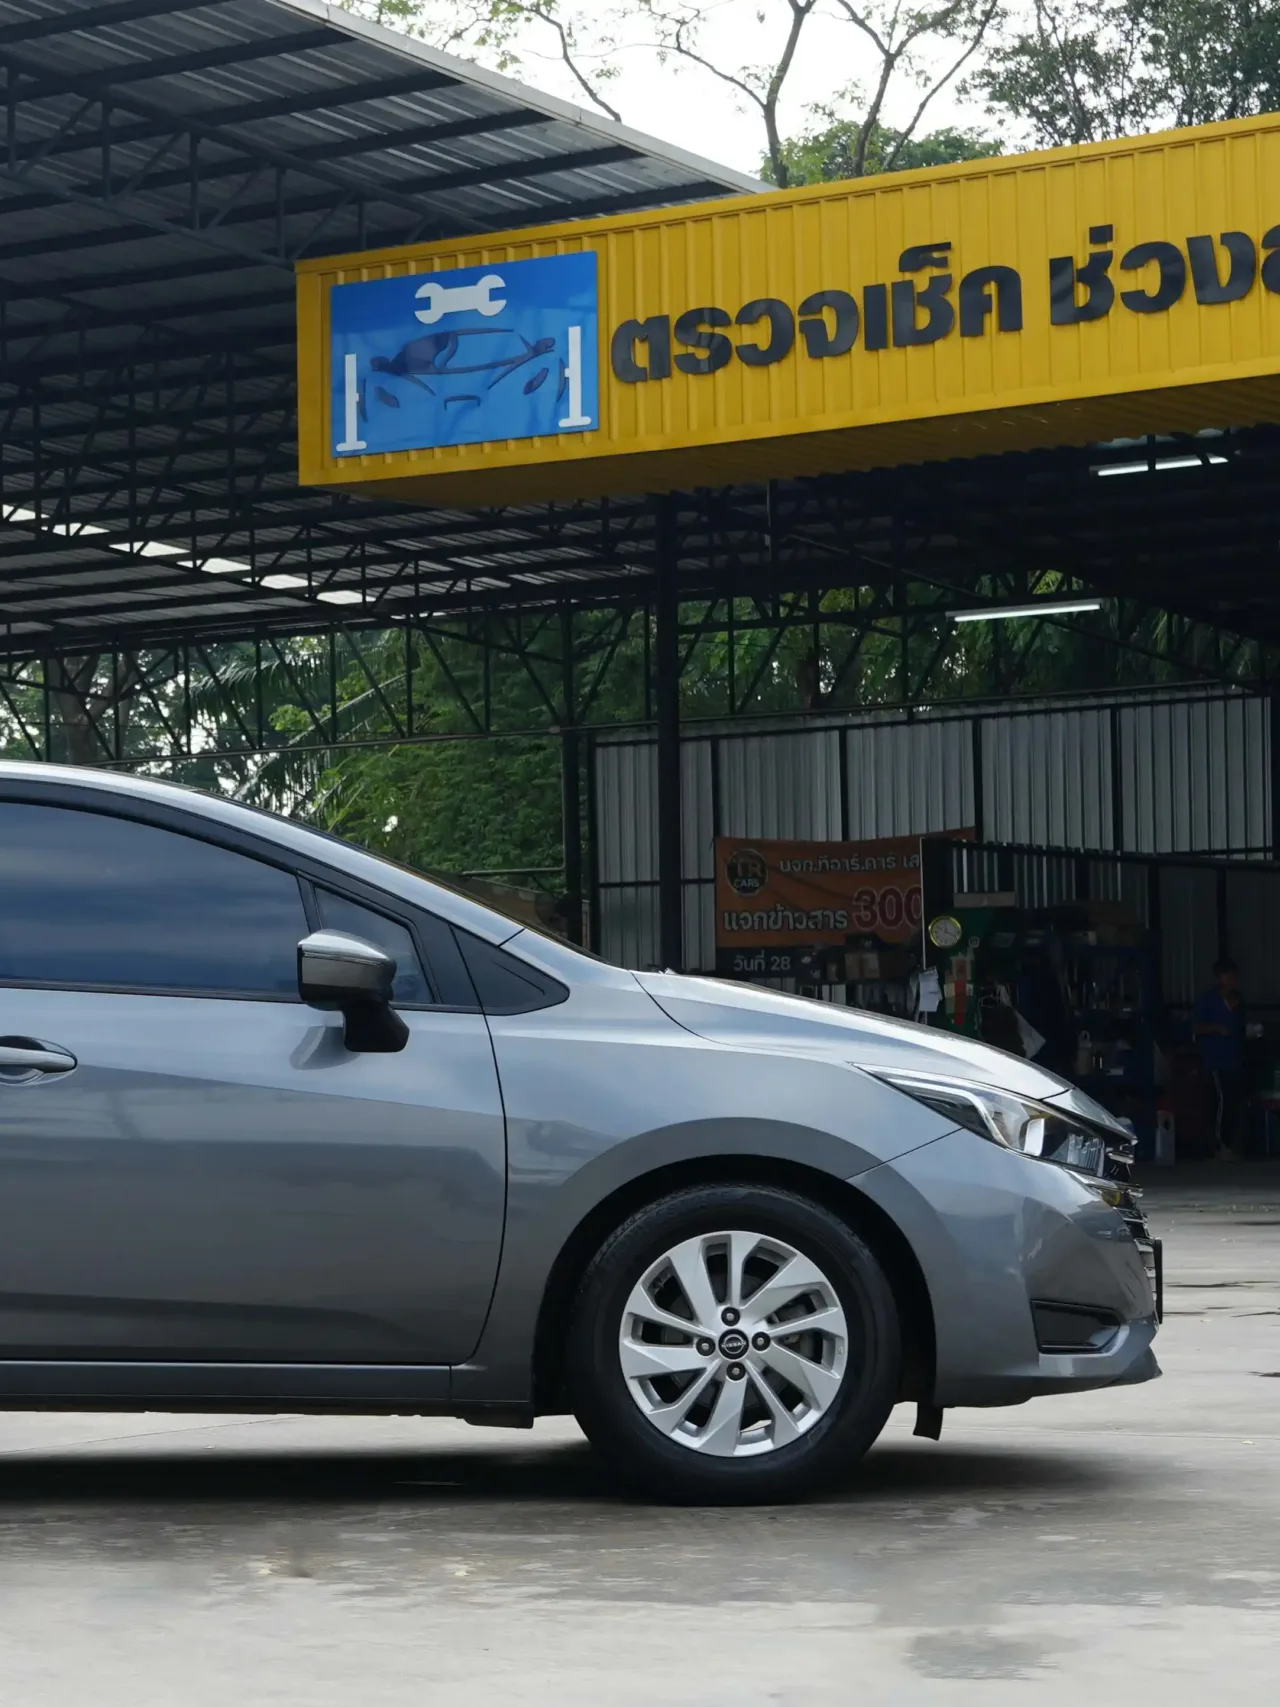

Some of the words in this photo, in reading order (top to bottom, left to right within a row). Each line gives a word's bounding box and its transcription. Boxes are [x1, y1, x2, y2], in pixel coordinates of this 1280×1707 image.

[611, 242, 1023, 383] ตรวจเช็ค
[733, 877, 760, 889] CARS
[723, 903, 849, 931] แจกข้าวสาร
[733, 949, 766, 971] วันที่
[770, 955, 791, 971] 28
